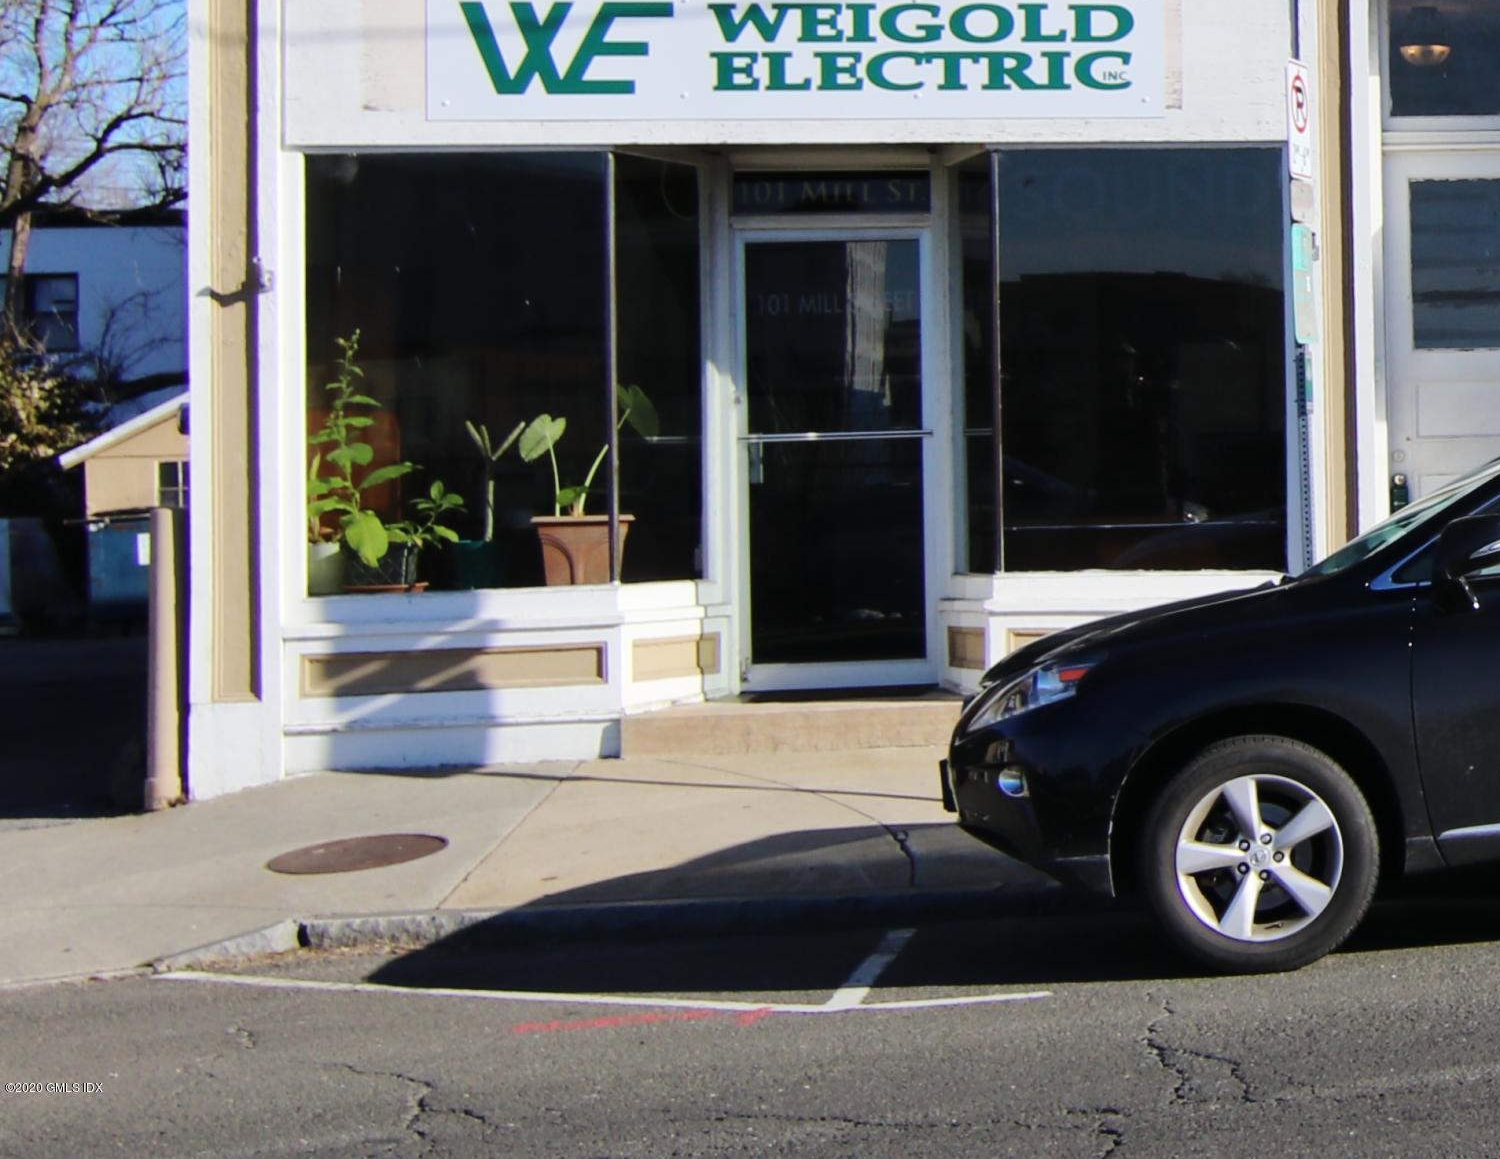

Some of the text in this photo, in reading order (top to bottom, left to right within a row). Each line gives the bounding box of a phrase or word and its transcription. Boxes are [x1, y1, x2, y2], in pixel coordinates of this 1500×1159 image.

[708, 3, 1135, 43] WEIGOLD
[709, 50, 1133, 91] ELECTRIC
[1102, 70, 1128, 82] INC
[740, 181, 786, 203] 101
[801, 180, 877, 203] MILL
[756, 293, 790, 315] 101
[797, 293, 843, 314] MILL
